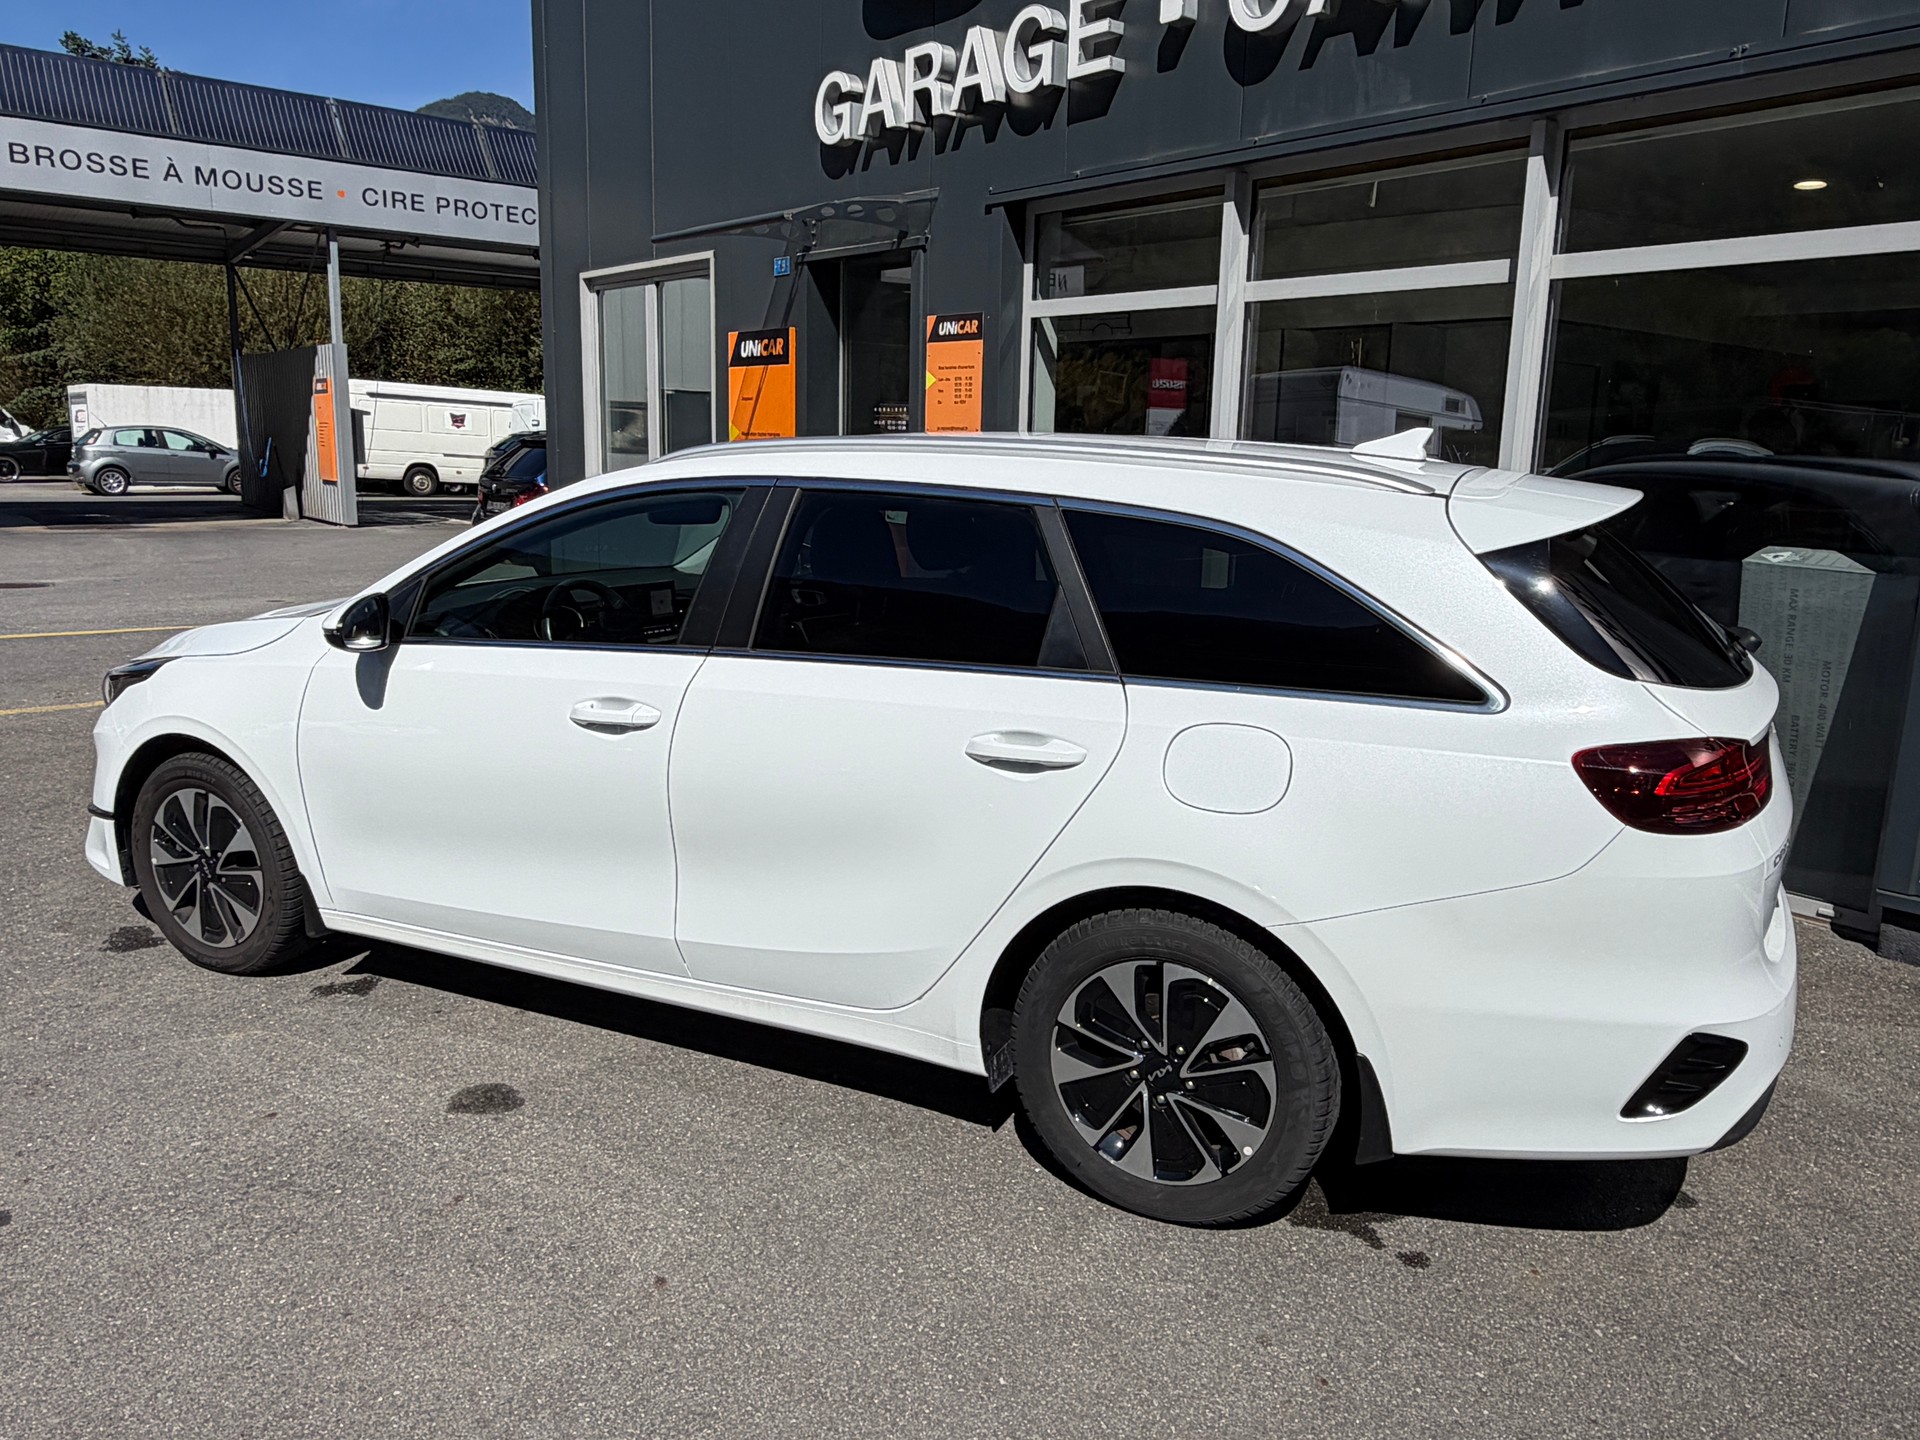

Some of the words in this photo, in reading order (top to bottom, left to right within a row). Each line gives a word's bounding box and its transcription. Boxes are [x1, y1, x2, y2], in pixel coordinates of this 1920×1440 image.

[815, 0, 1125, 146] GARAGE
[8, 142, 150, 179] BROSSE
[163, 156, 183, 184] À
[194, 166, 323, 200] MOUSSE
[362, 187, 425, 212] CIRE
[436, 196, 537, 225] PROTEC
[1788, 588, 1800, 611] MAX
[1783, 653, 1794, 665] 30
[1781, 668, 1792, 683] KM
[1817, 703, 1828, 720] 400
[1815, 723, 1826, 748] WATT
